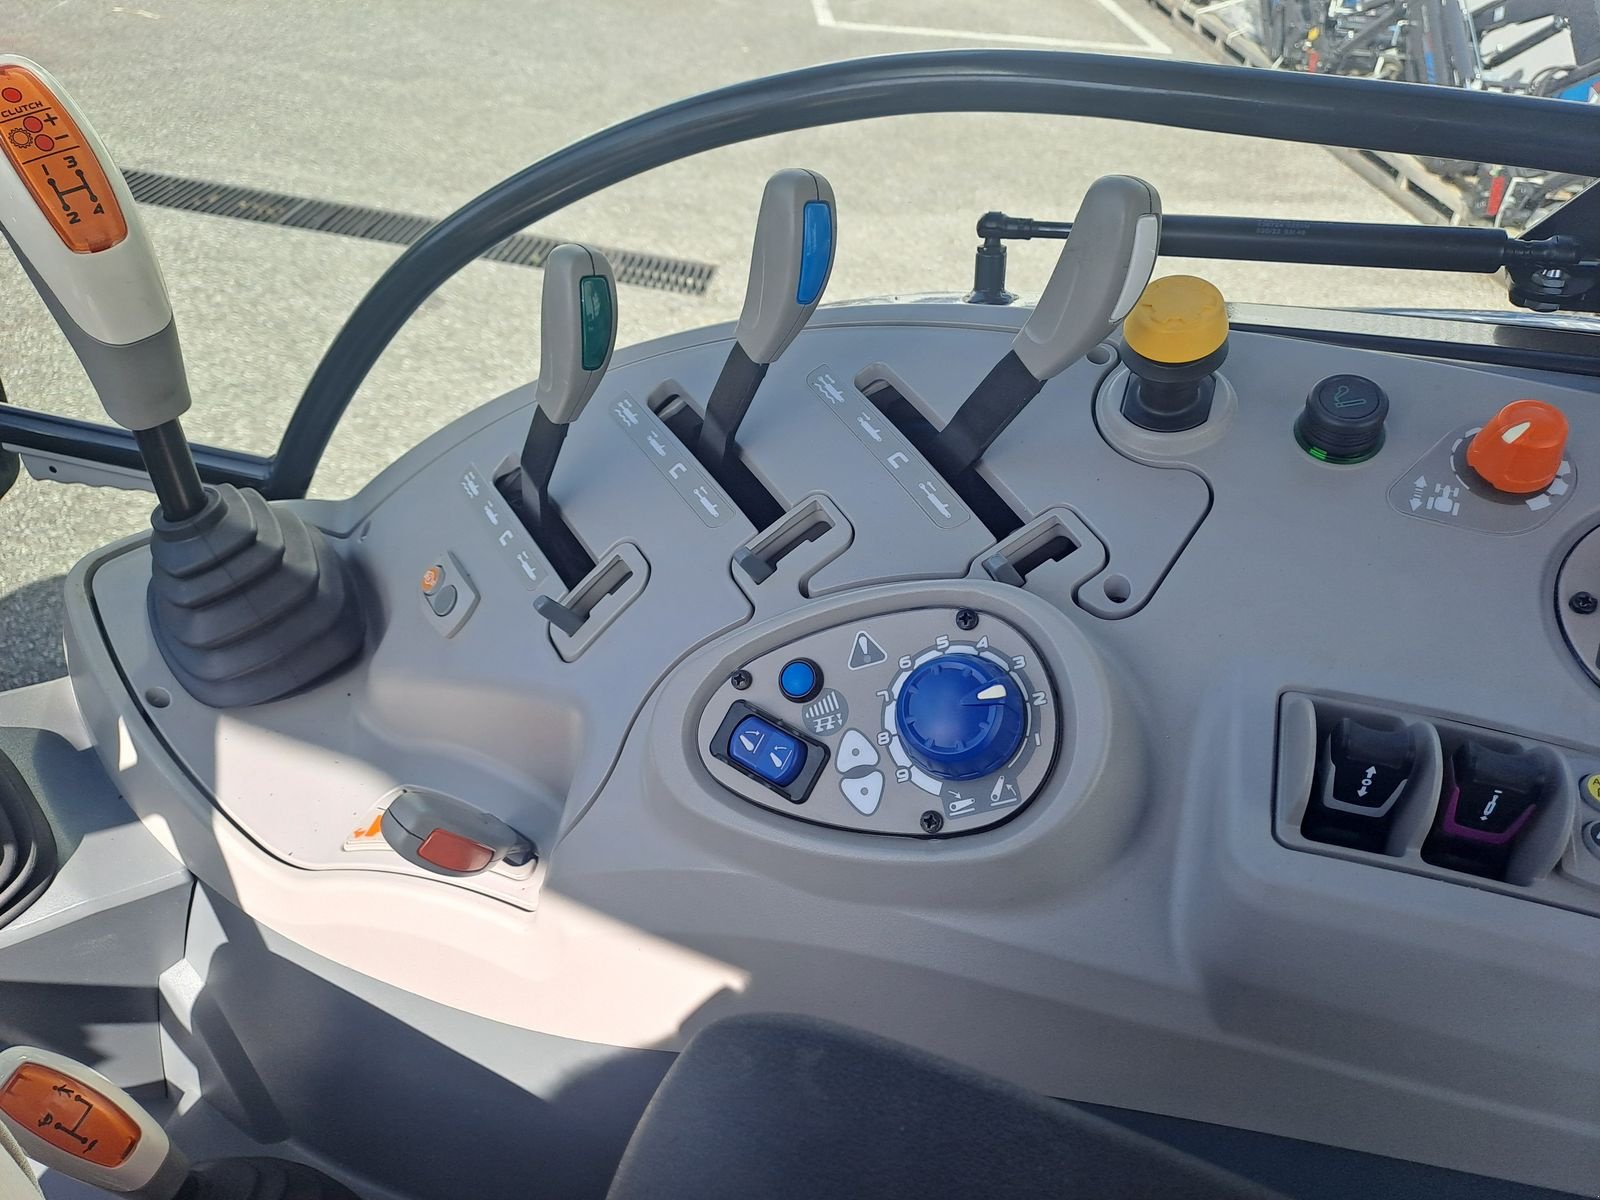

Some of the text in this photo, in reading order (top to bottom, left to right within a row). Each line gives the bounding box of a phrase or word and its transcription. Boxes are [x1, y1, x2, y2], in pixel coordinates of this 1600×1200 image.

[1, 101, 44, 118] CLUTCH
[63, 155, 78, 169] 3
[93, 202, 105, 215] 4
[66, 211, 81, 225] 2
[935, 636, 950, 649] 5
[976, 636, 989, 649] 4
[898, 655, 912, 669] 6
[1012, 655, 1026, 670] 3
[876, 690, 890, 702] 7
[1031, 691, 1048, 706] 2
[877, 731, 890, 746] 8
[1034, 732, 1041, 747] 1
[895, 768, 910, 783] 9
